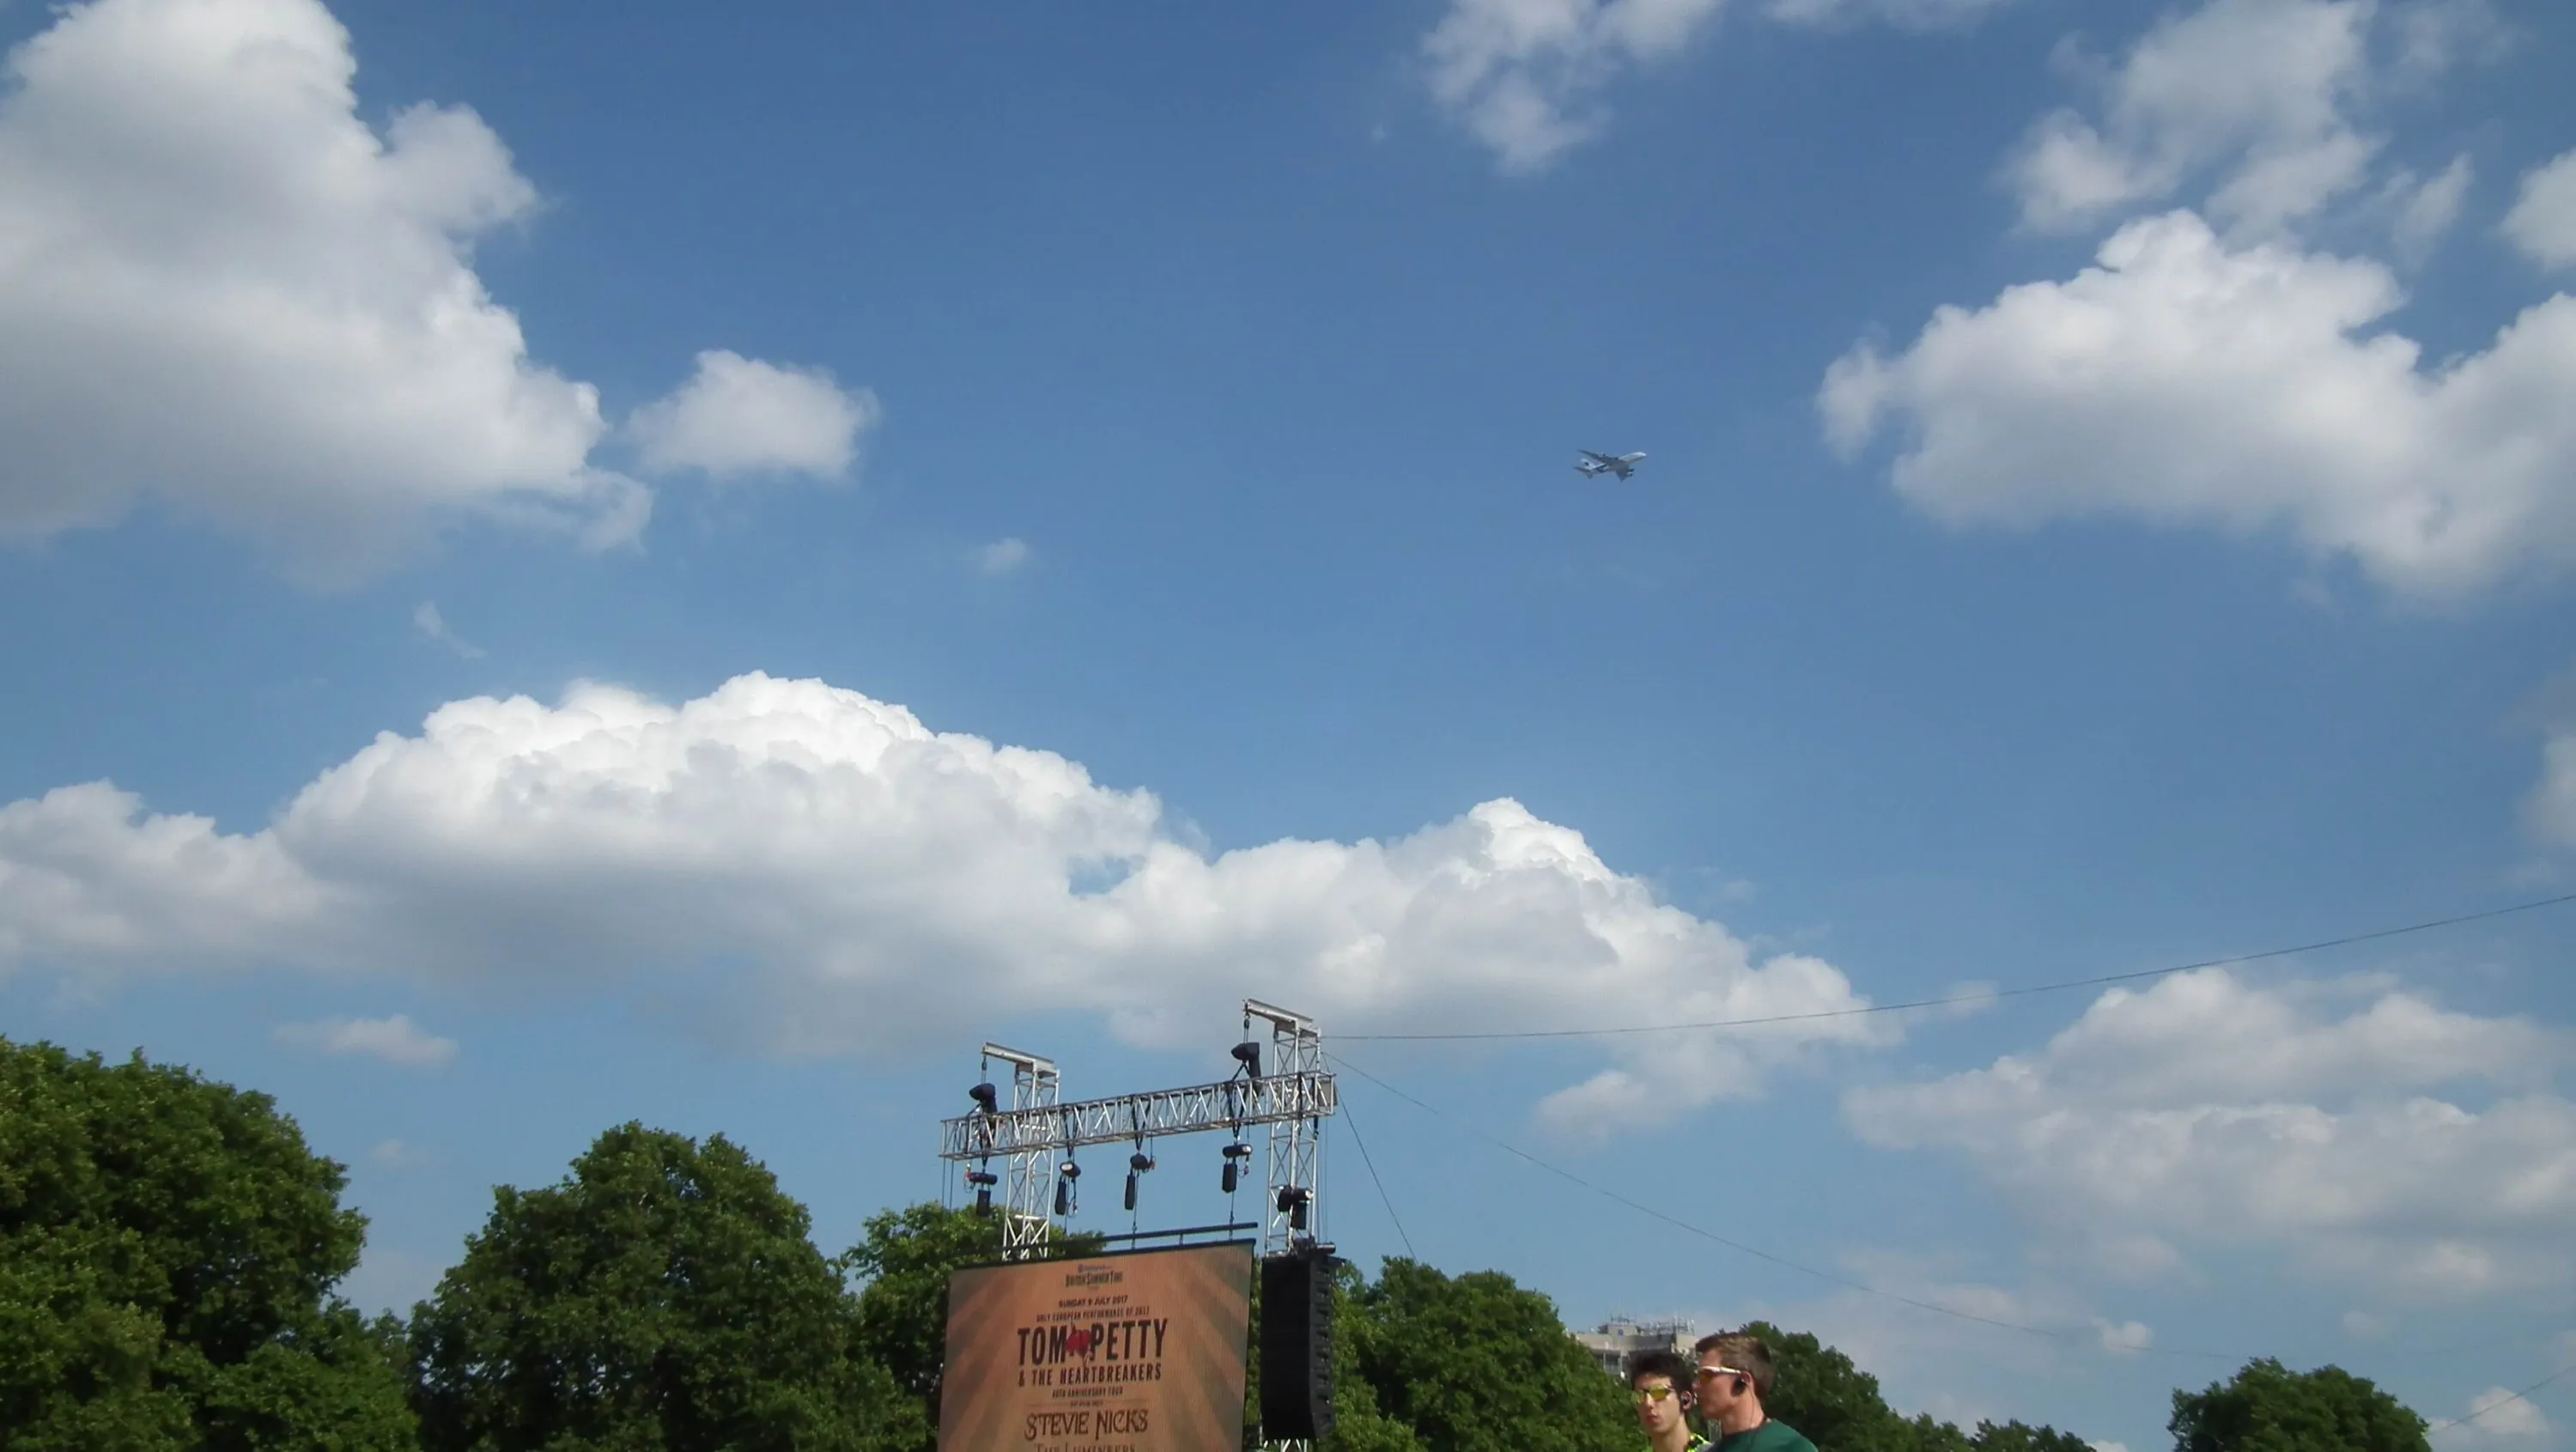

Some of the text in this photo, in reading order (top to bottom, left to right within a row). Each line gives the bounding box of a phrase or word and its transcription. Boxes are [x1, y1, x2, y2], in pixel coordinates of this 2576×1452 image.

[1059, 1298, 1085, 1308] SUNDAY
[1094, 1297, 1109, 1305] JULY
[1112, 1295, 1128, 1304] 2017
[1036, 1305, 1150, 1322] ONLY EUROPEAN PERFORMANCE OF 2017
[1018, 1318, 1168, 1365] TOM PETTY
[1018, 1363, 1162, 1387] & THE HEARTBREAKERS
[1053, 1386, 1123, 1398] 40TH ANNIVERSARY TOUR
[1024, 1408, 1149, 1441] STEVIE NICKS
